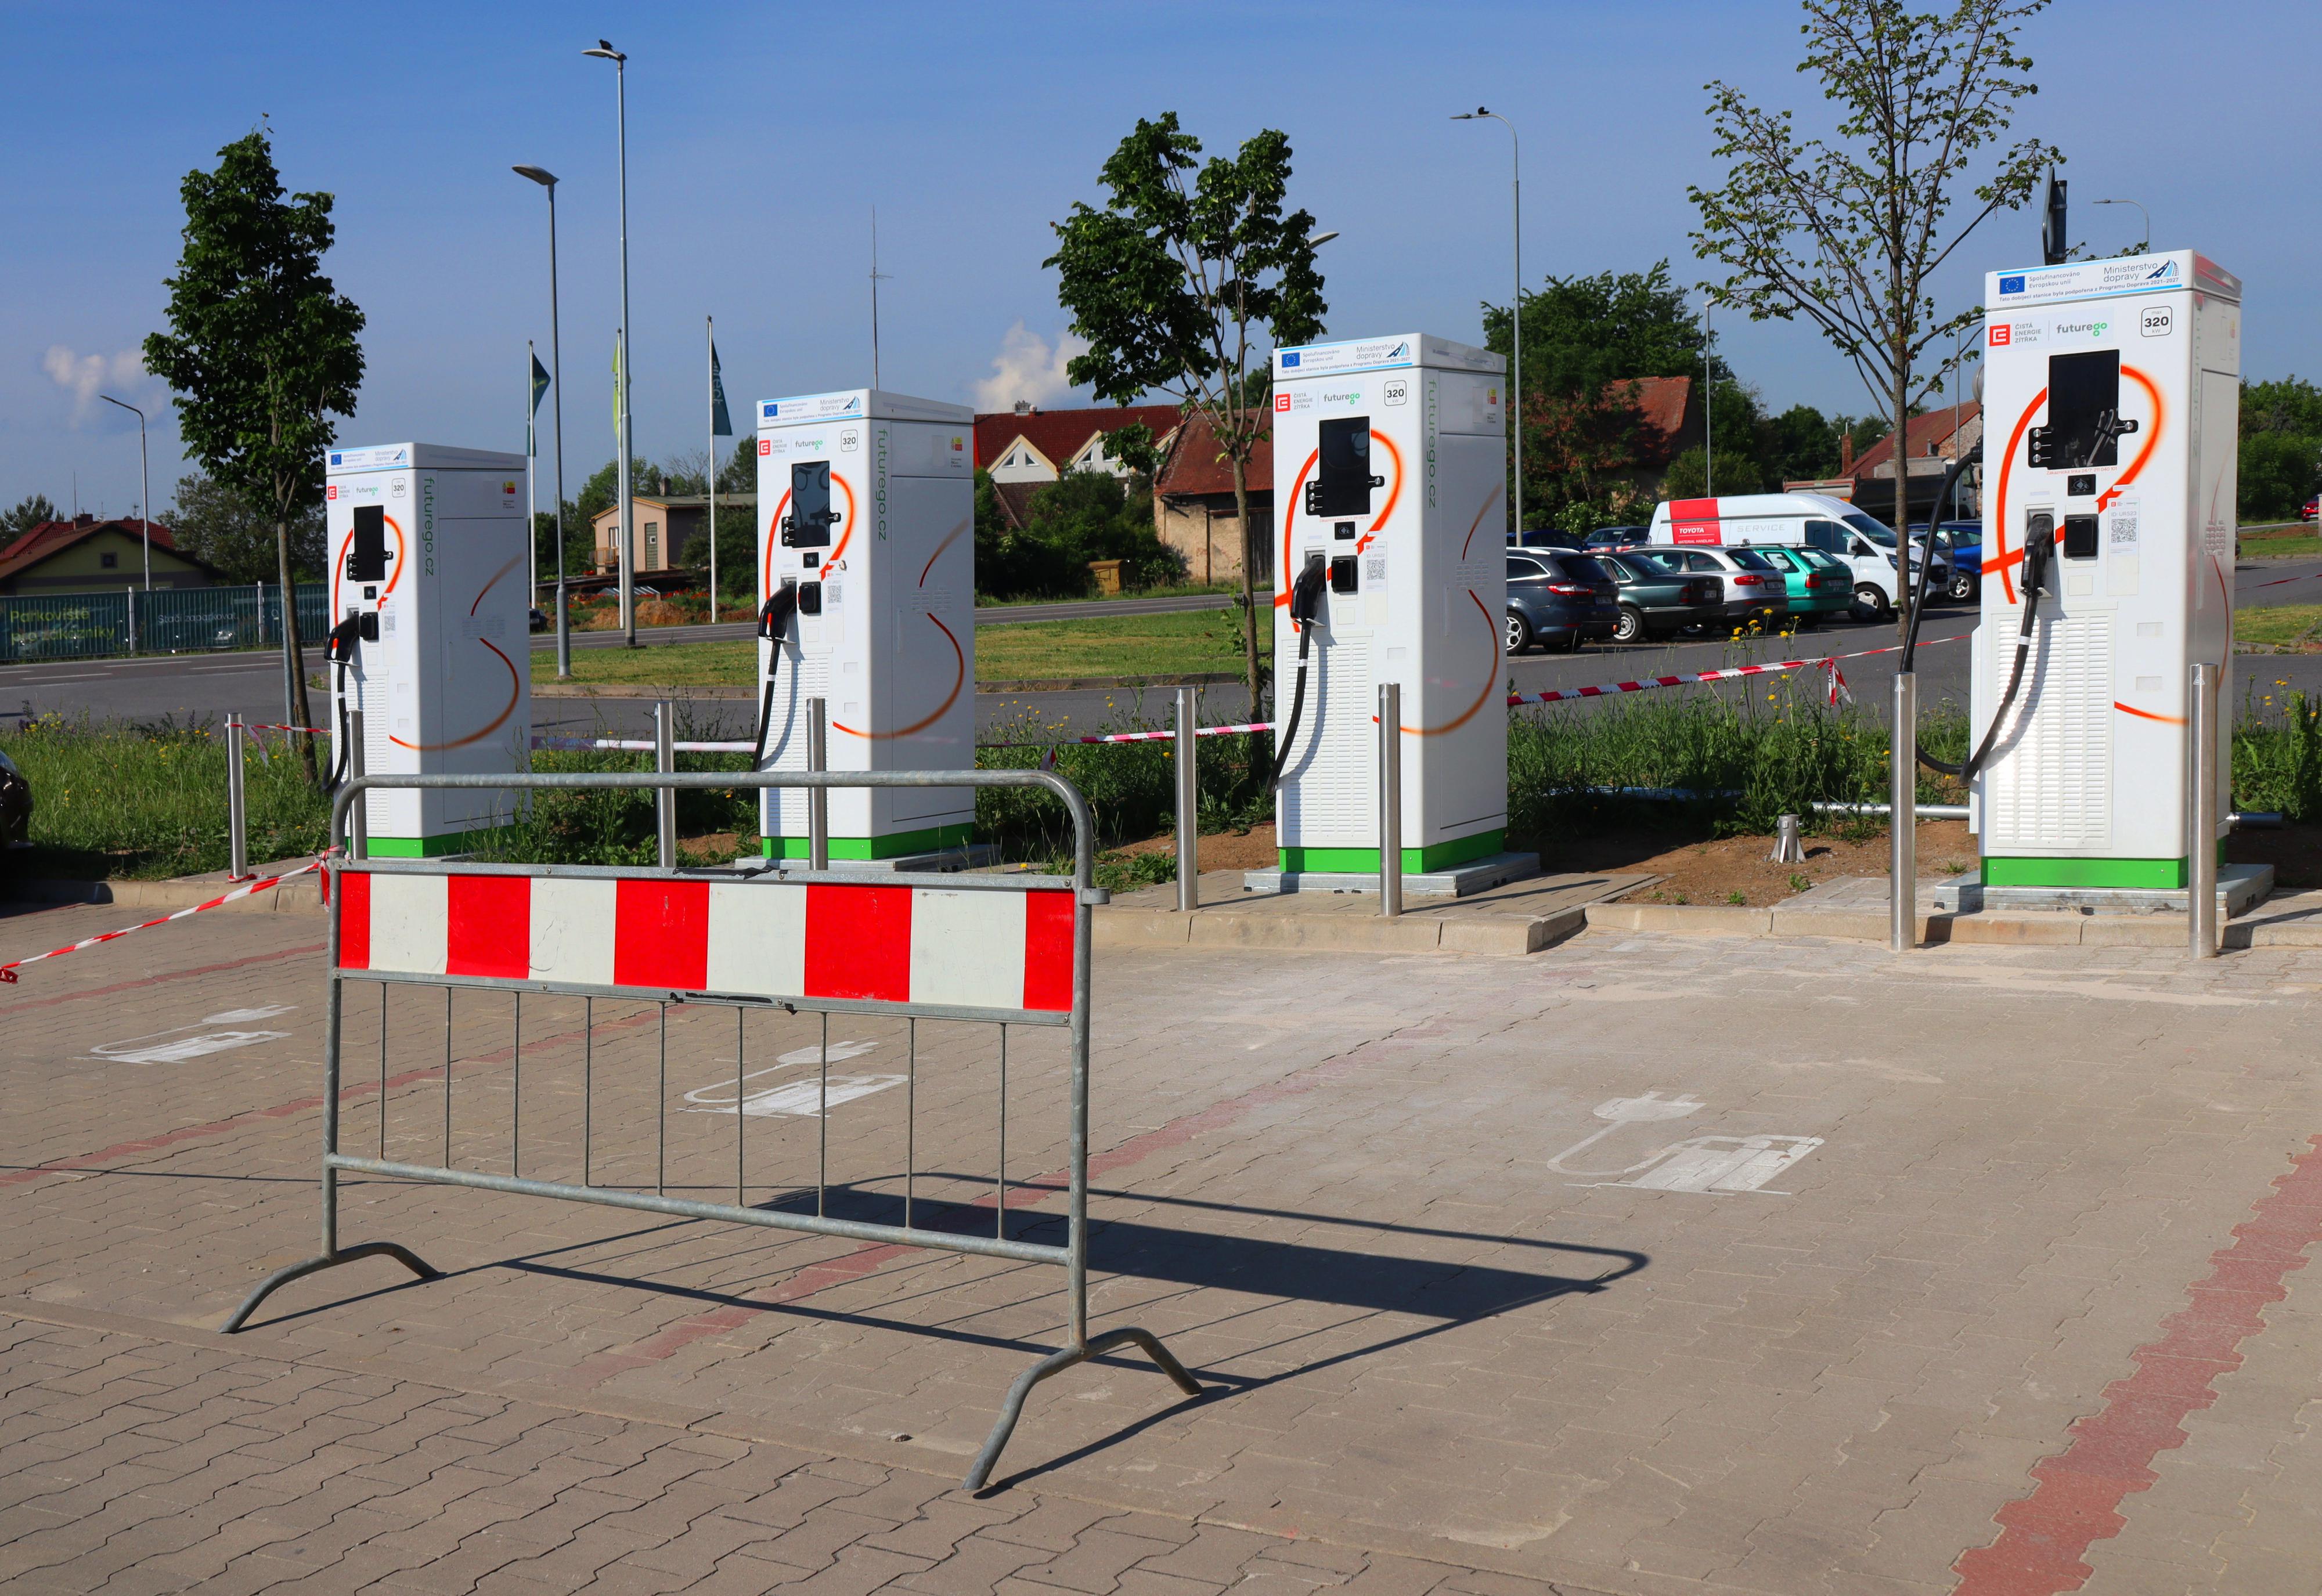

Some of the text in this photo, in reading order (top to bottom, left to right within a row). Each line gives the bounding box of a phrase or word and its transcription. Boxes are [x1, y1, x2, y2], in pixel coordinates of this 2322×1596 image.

[2104, 262, 2158, 275] Ministerstvo
[2029, 271, 2081, 282] Spolufinancováno
[2104, 272, 2140, 283] dopravy
[2029, 281, 2059, 289] Evropskou
[2099, 283, 2125, 293] Programu
[2144, 316, 2169, 328] 320
[1357, 343, 1395, 353] Ministerstvo
[1356, 352, 1382, 360] dopravy
[1387, 389, 1404, 398] 320
[820, 397, 849, 405] Ministerstvo
[842, 436, 856, 445] 320
[1426, 379, 1437, 508] futurego.cz
[875, 429, 888, 541] futurego.cz
[422, 477, 435, 576] futurego.cz
[1737, 524, 1786, 533] SERVICE
